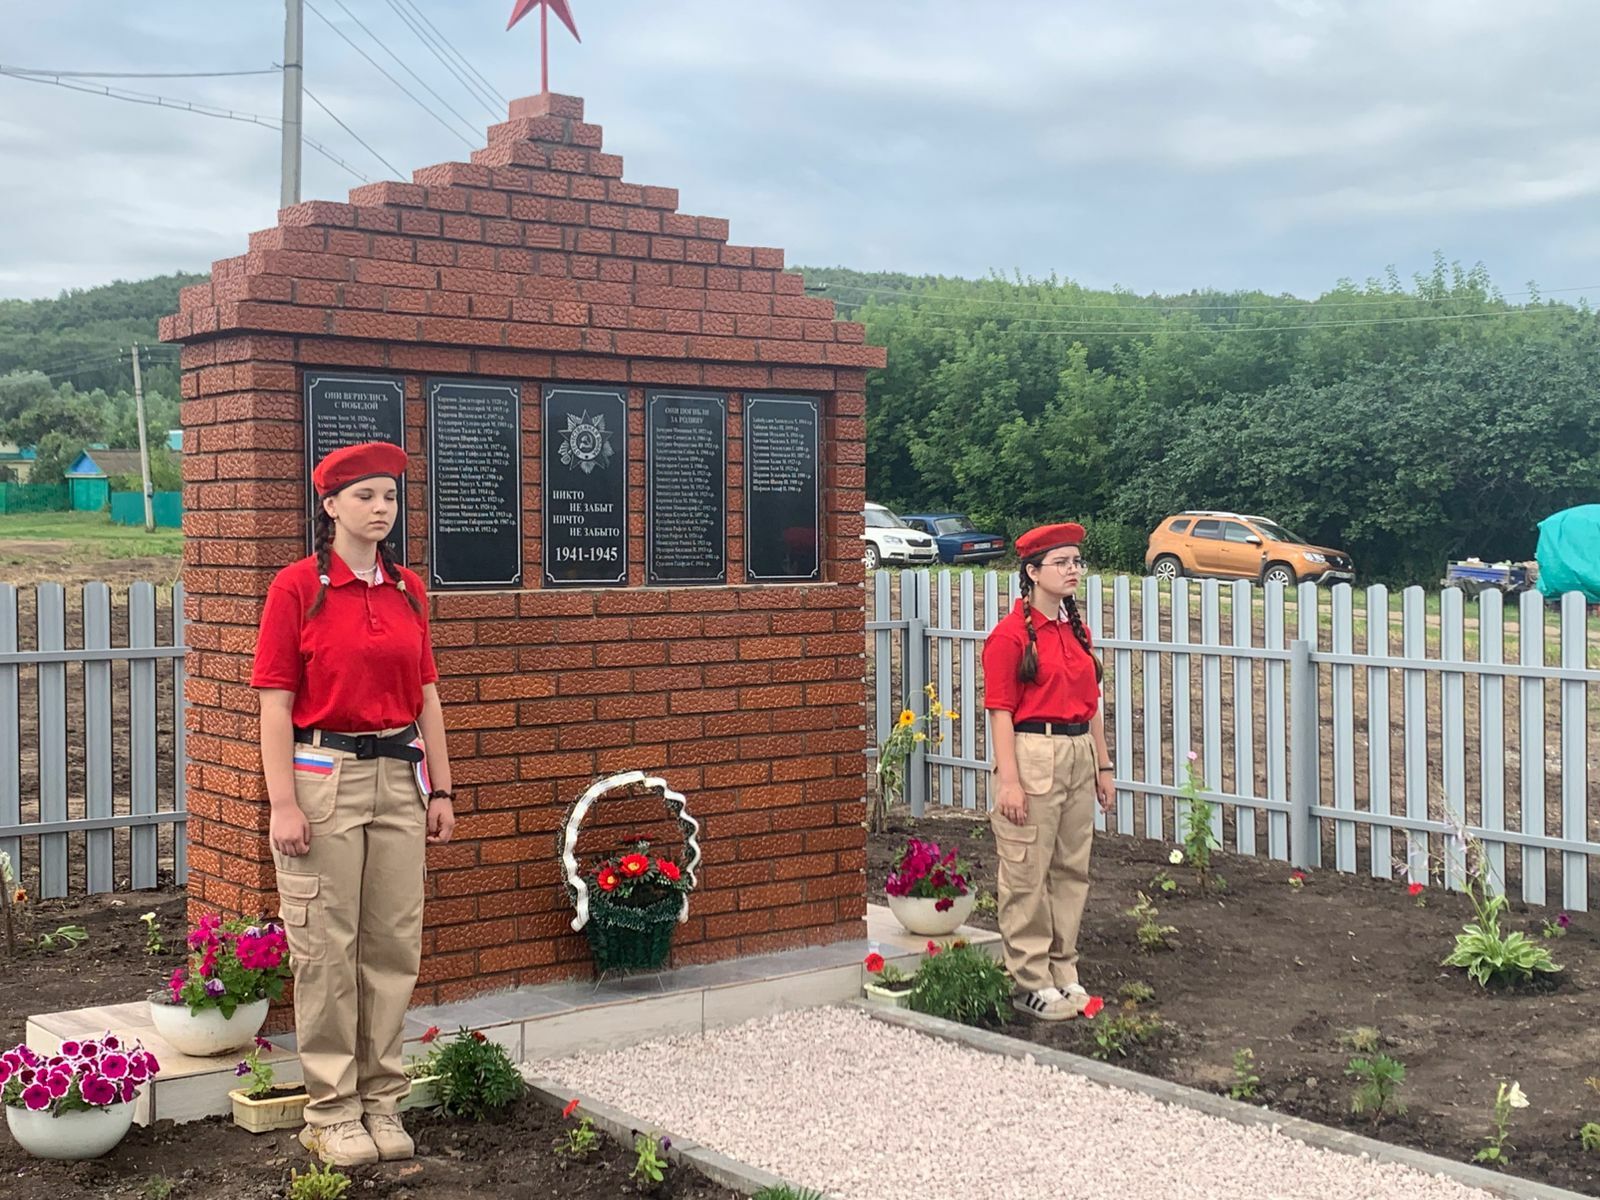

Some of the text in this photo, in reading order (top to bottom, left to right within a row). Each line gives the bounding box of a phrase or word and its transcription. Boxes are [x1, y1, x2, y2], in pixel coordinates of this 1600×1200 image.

[325, 392, 388, 401] ОНИ ВЕРНУЛИСЬ
[342, 402, 378, 410] ПОБЕДОЙ
[553, 490, 584, 500] НИКТО
[570, 503, 614, 512] НЕ ЗАБЫТ
[553, 515, 584, 524] НИЧТО
[570, 528, 620, 537] НЕ ЗАБЫТО
[556, 547, 618, 561] 1941-1945
